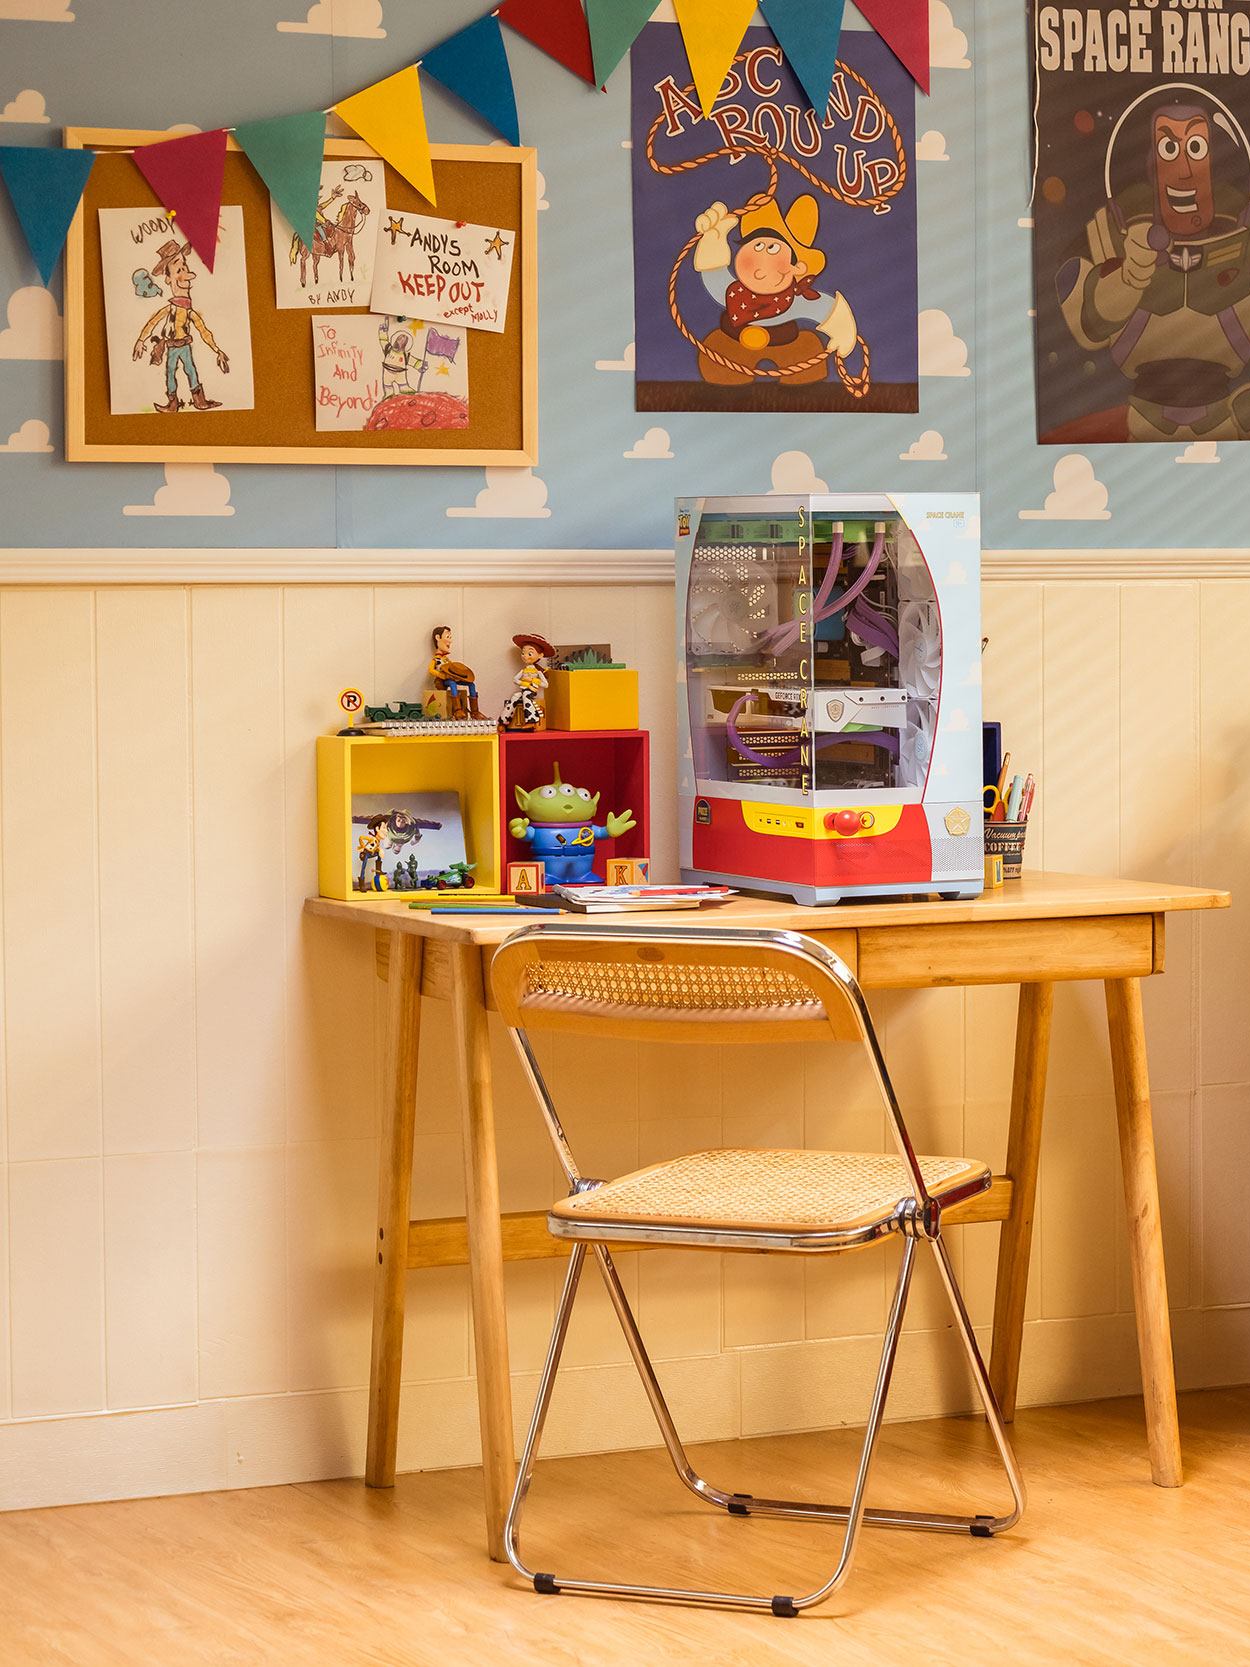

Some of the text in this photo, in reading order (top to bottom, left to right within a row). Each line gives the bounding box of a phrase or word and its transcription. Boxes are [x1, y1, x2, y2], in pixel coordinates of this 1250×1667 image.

[1039, 6, 1153, 73] SPACE
[709, 72, 886, 165] ROUND
[834, 144, 899, 215] UP
[131, 218, 176, 244] WOODY
[410, 227, 461, 256] ANDYS
[308, 289, 355, 305] BY ANDY
[397, 271, 485, 303] KEEP OUT
[443, 303, 473, 319] except
[333, 358, 358, 382] And
[318, 379, 379, 418] Beyond!
[797, 505, 809, 795] SPACE CRANE
[347, 695, 357, 707] P
[775, 691, 793, 700] GEFORCE
[984, 828, 1016, 840] Vacuum
[984, 841, 1022, 852] COFFEE
[515, 868, 532, 890] A
[615, 864, 629, 886] K
